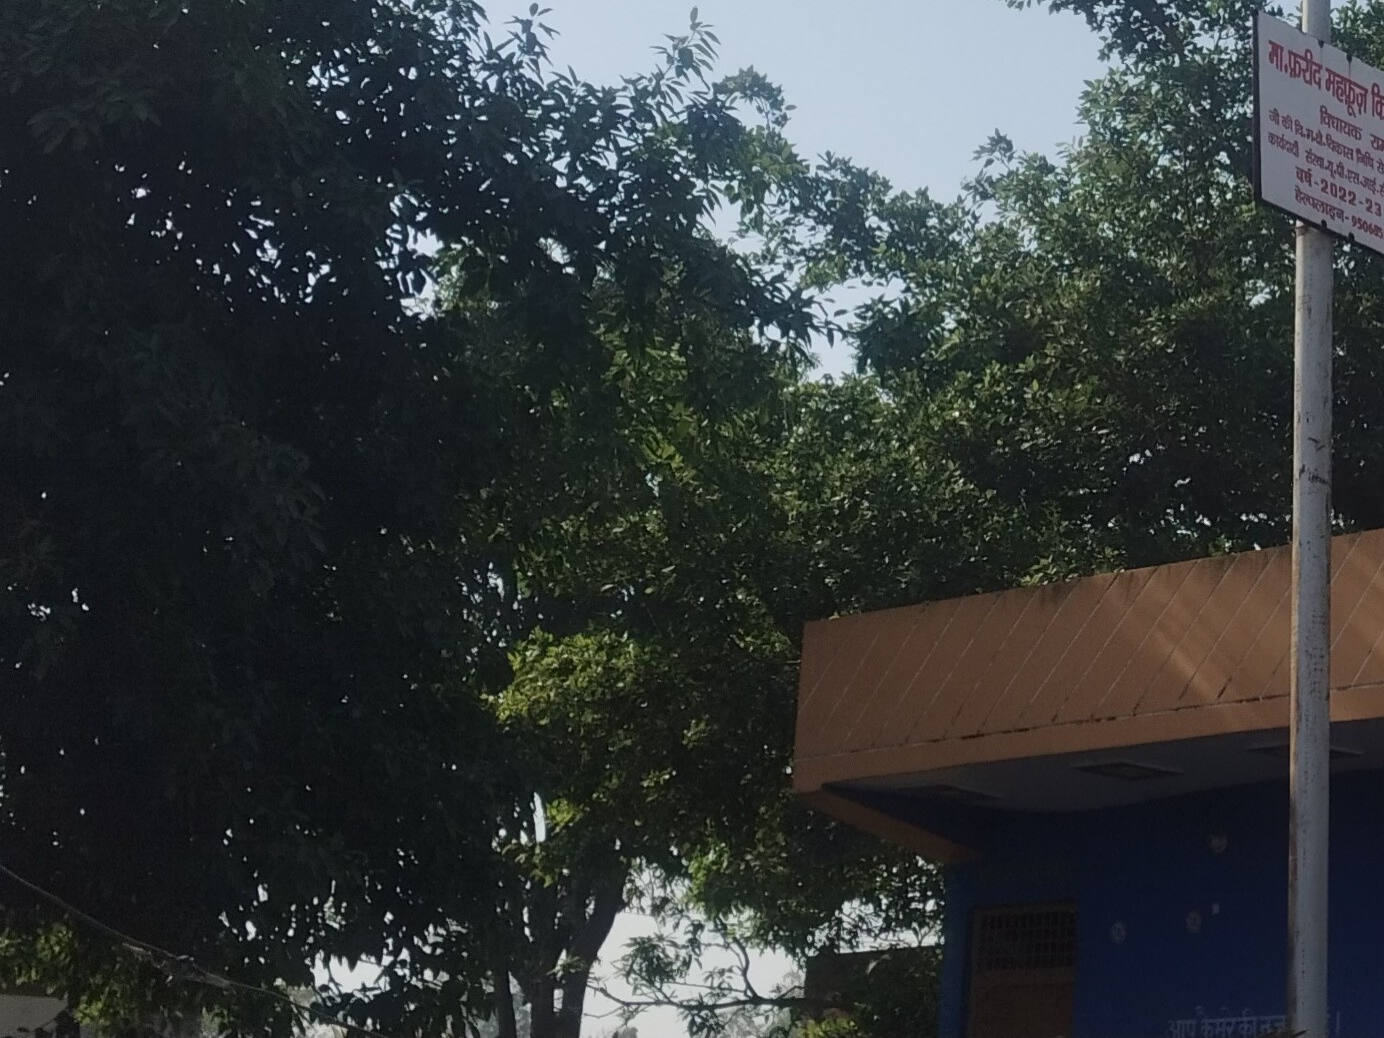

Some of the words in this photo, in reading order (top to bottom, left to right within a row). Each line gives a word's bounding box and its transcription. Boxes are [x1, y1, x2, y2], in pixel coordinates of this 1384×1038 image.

[1281, 114, 1293, 133] की
[1355, 148, 1375, 170] निधि
[1376, 157, 1384, 175] से
[1319, 105, 1363, 141] विधायक
